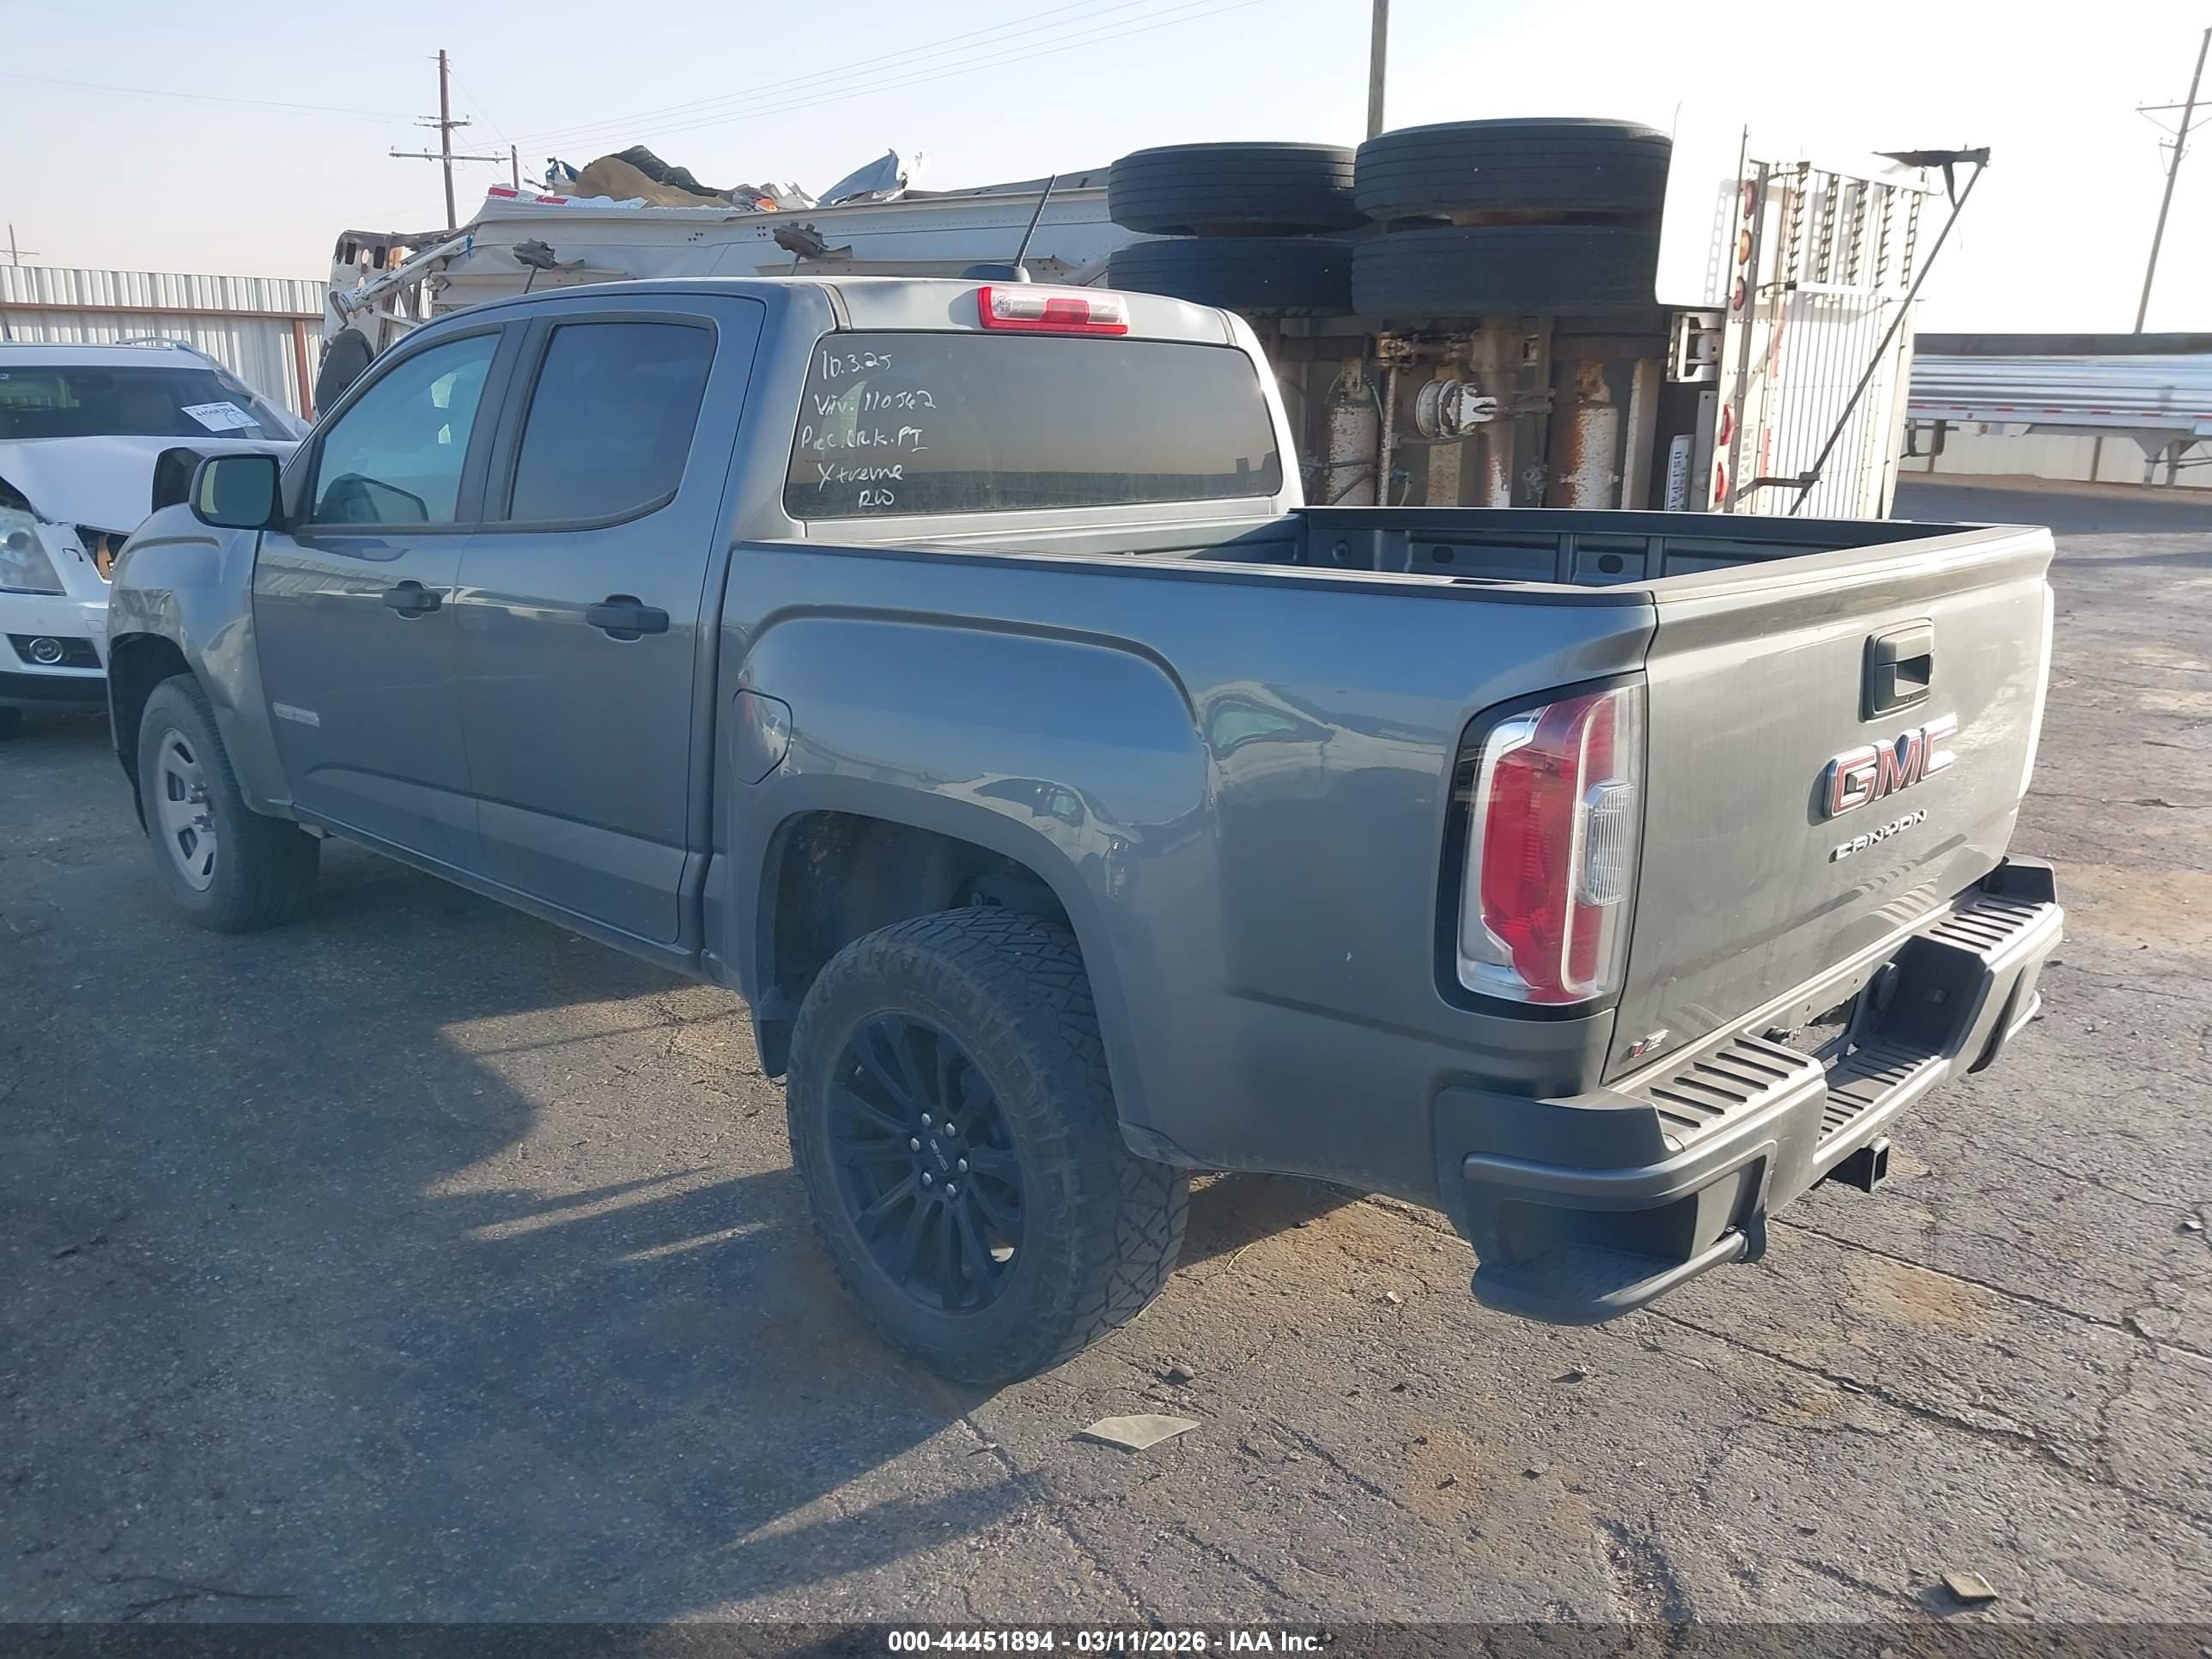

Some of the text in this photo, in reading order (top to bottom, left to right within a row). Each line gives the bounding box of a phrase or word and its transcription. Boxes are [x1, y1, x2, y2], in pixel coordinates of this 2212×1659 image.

[817, 462, 903, 493] Xtreme
[1819, 712, 1959, 819] GMC
[1829, 808, 1928, 863] CANYON
